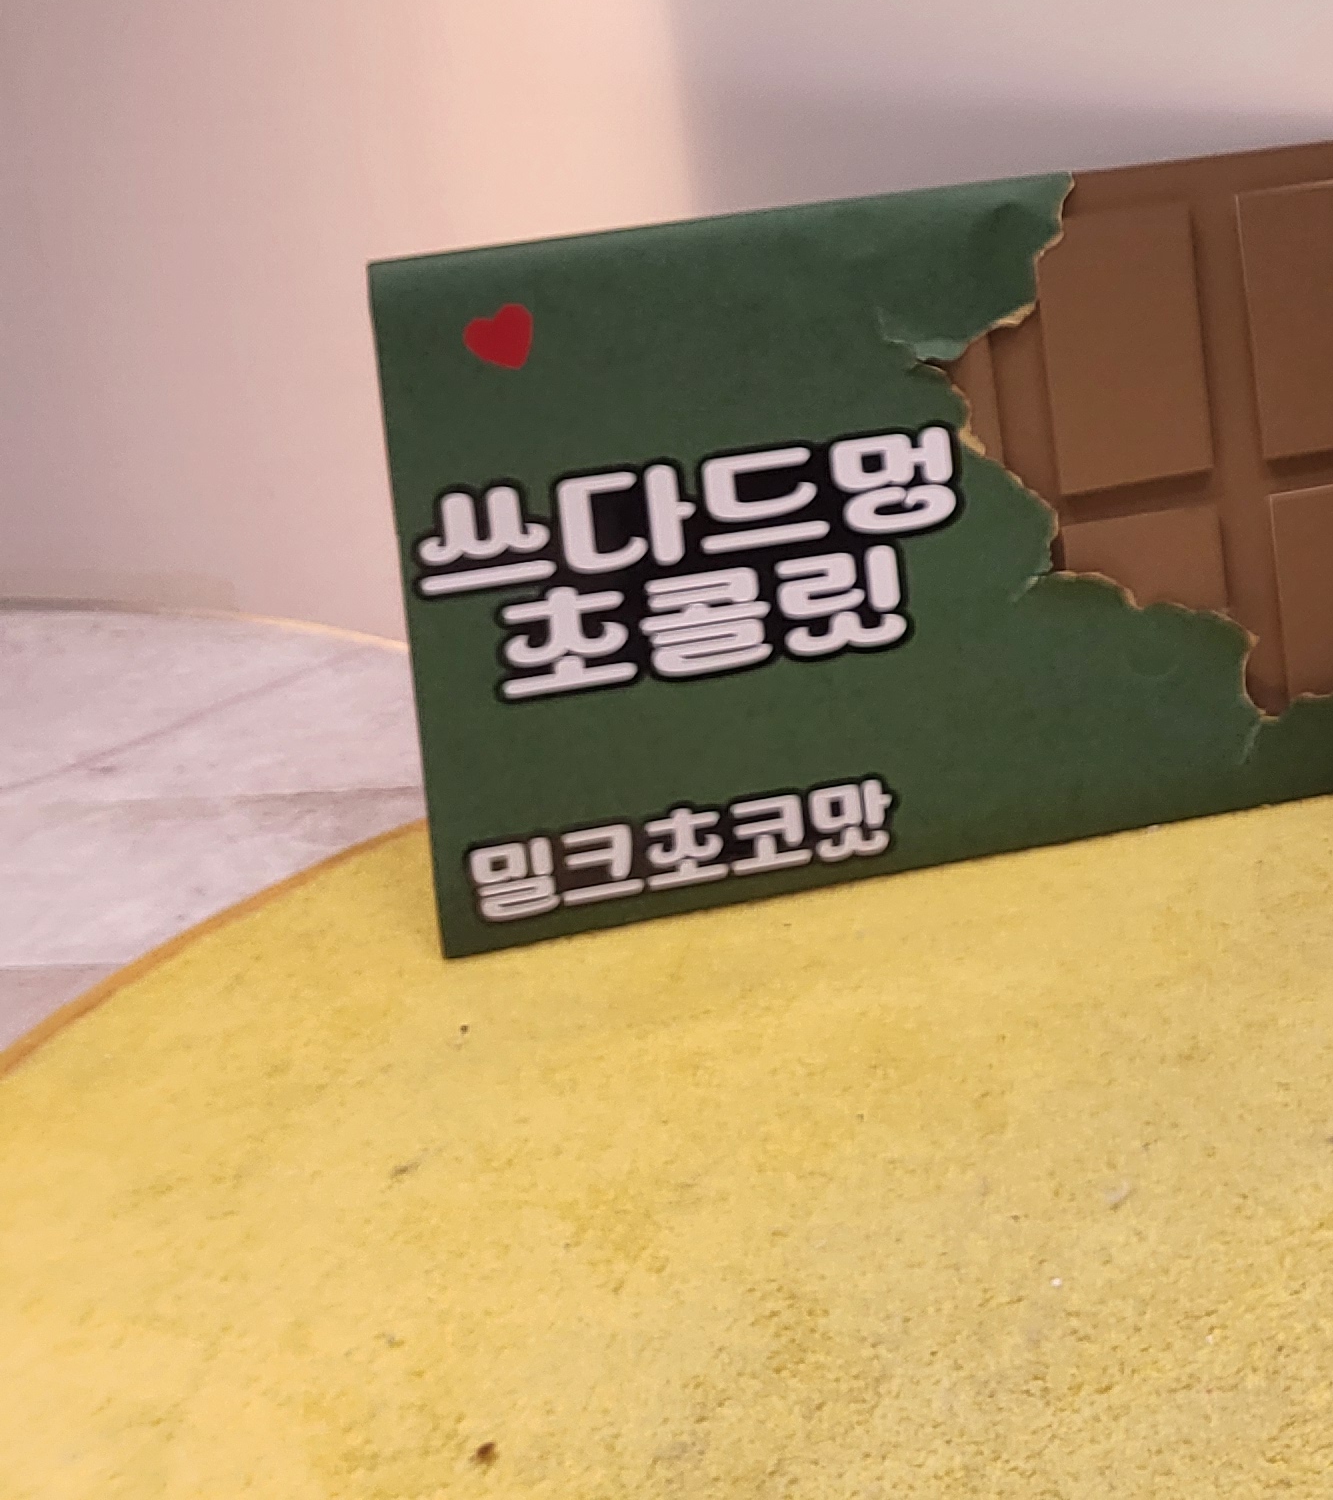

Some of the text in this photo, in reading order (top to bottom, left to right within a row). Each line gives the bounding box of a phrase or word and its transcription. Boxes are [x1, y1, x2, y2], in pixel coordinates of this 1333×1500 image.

[414, 422, 963, 600] 쓰다드멍
[498, 542, 910, 702] 초콜릿
[467, 775, 894, 925] 밀크초코맛
